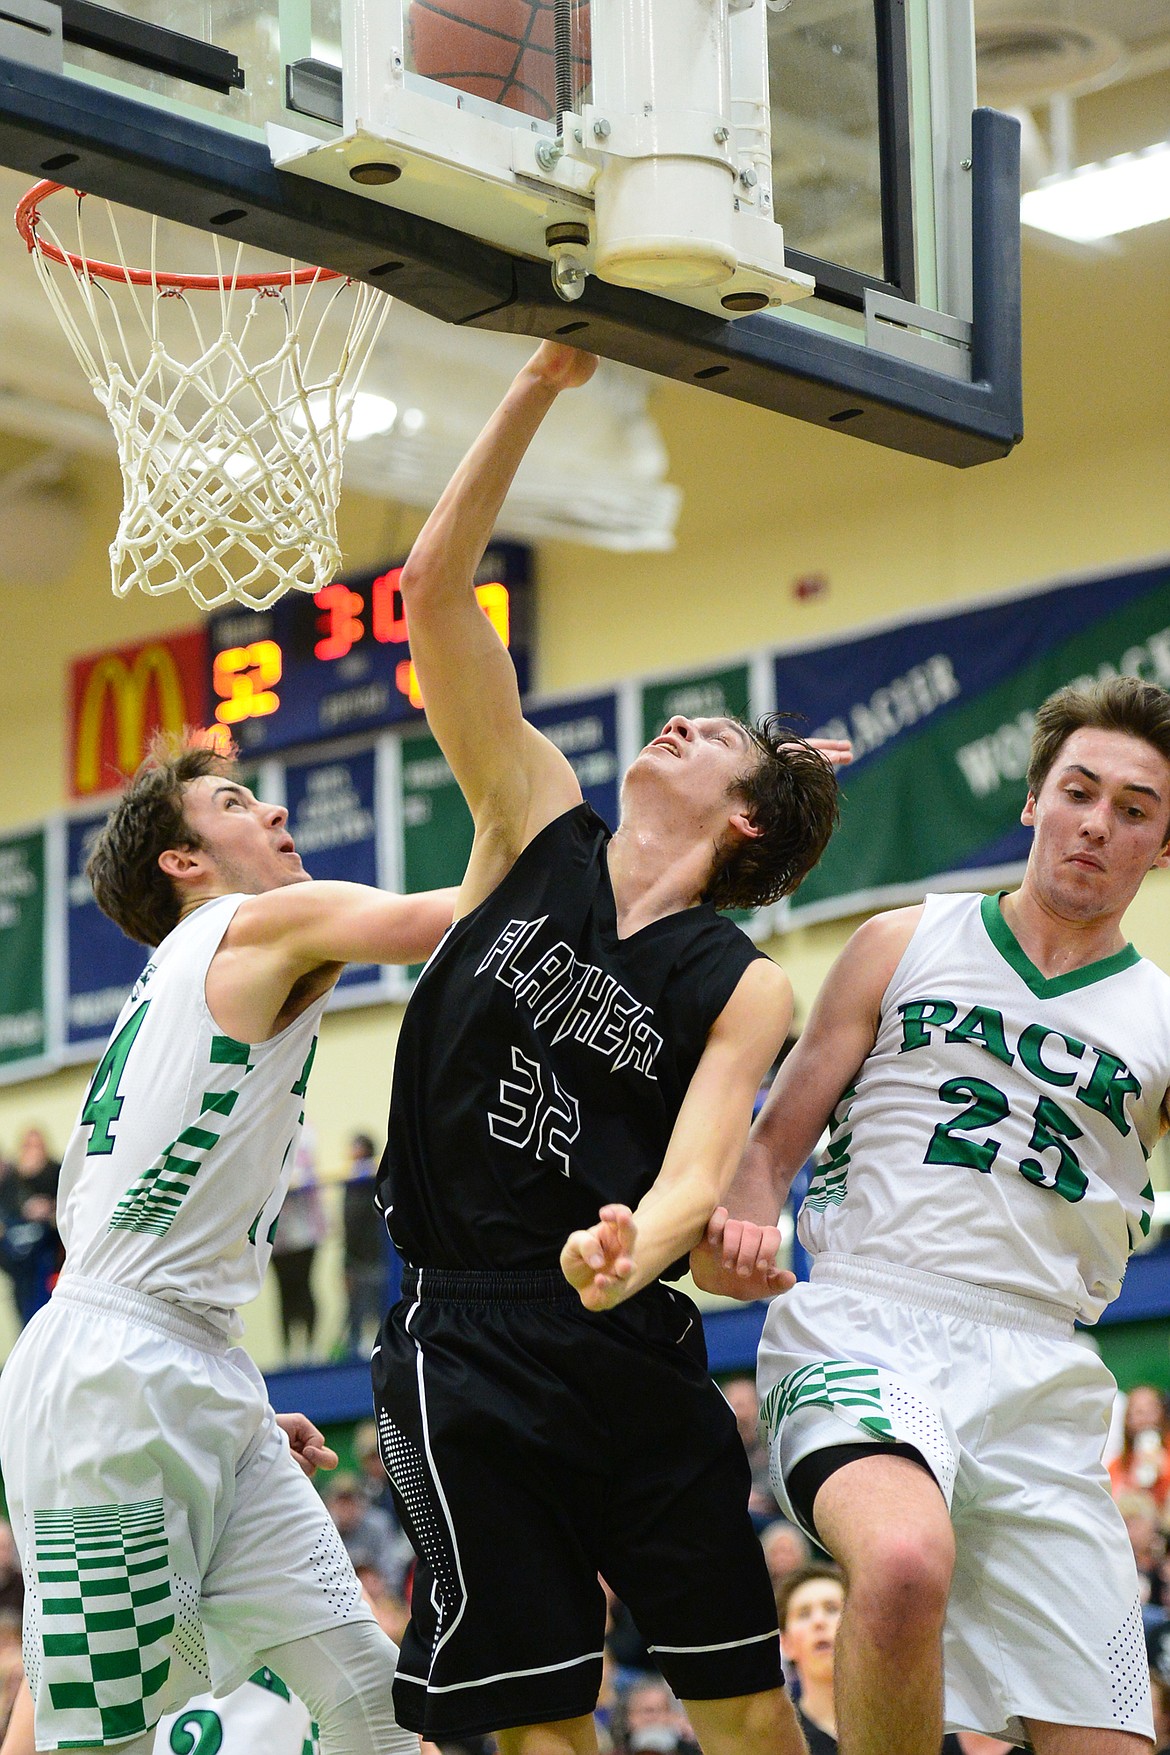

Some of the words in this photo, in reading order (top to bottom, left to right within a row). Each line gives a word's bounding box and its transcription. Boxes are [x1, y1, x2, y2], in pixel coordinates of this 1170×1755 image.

[487, 1045, 581, 1179] 32
[897, 998, 1143, 1138] PACK
[922, 1075, 1090, 1204] 25
